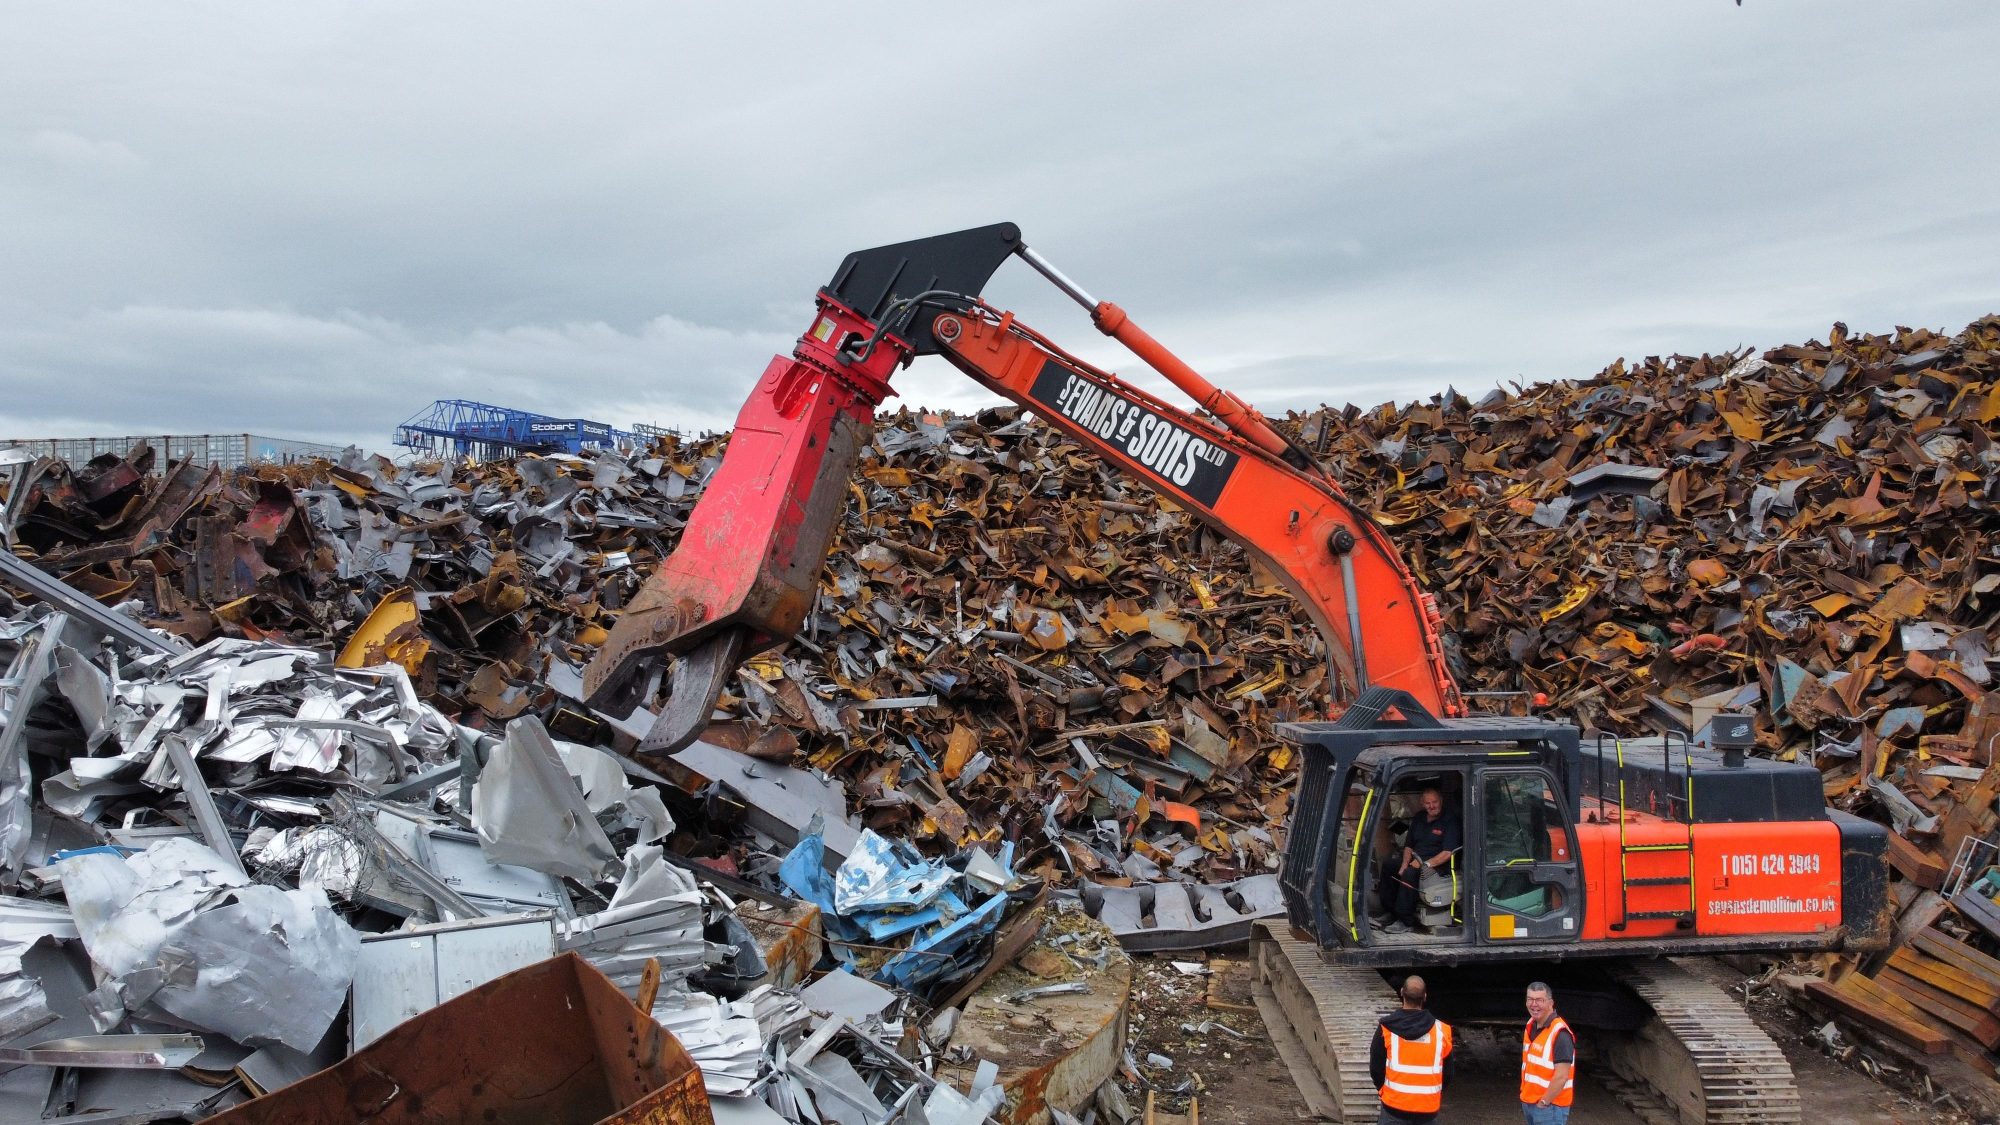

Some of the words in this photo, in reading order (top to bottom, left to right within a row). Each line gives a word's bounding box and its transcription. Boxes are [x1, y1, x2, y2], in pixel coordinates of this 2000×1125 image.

[1058, 374, 1076, 401] S
[1061, 379, 1127, 440] EVANS
[1119, 406, 1140, 438] &
[531, 423, 575, 431] Stobart
[583, 424, 608, 436] Stobart
[1127, 413, 1206, 487] SONS
[1204, 444, 1228, 467] LTD
[1721, 855, 1728, 876] T
[1732, 854, 1757, 876] 0151
[1761, 854, 1785, 875] 424
[1789, 854, 1820, 875] 3944
